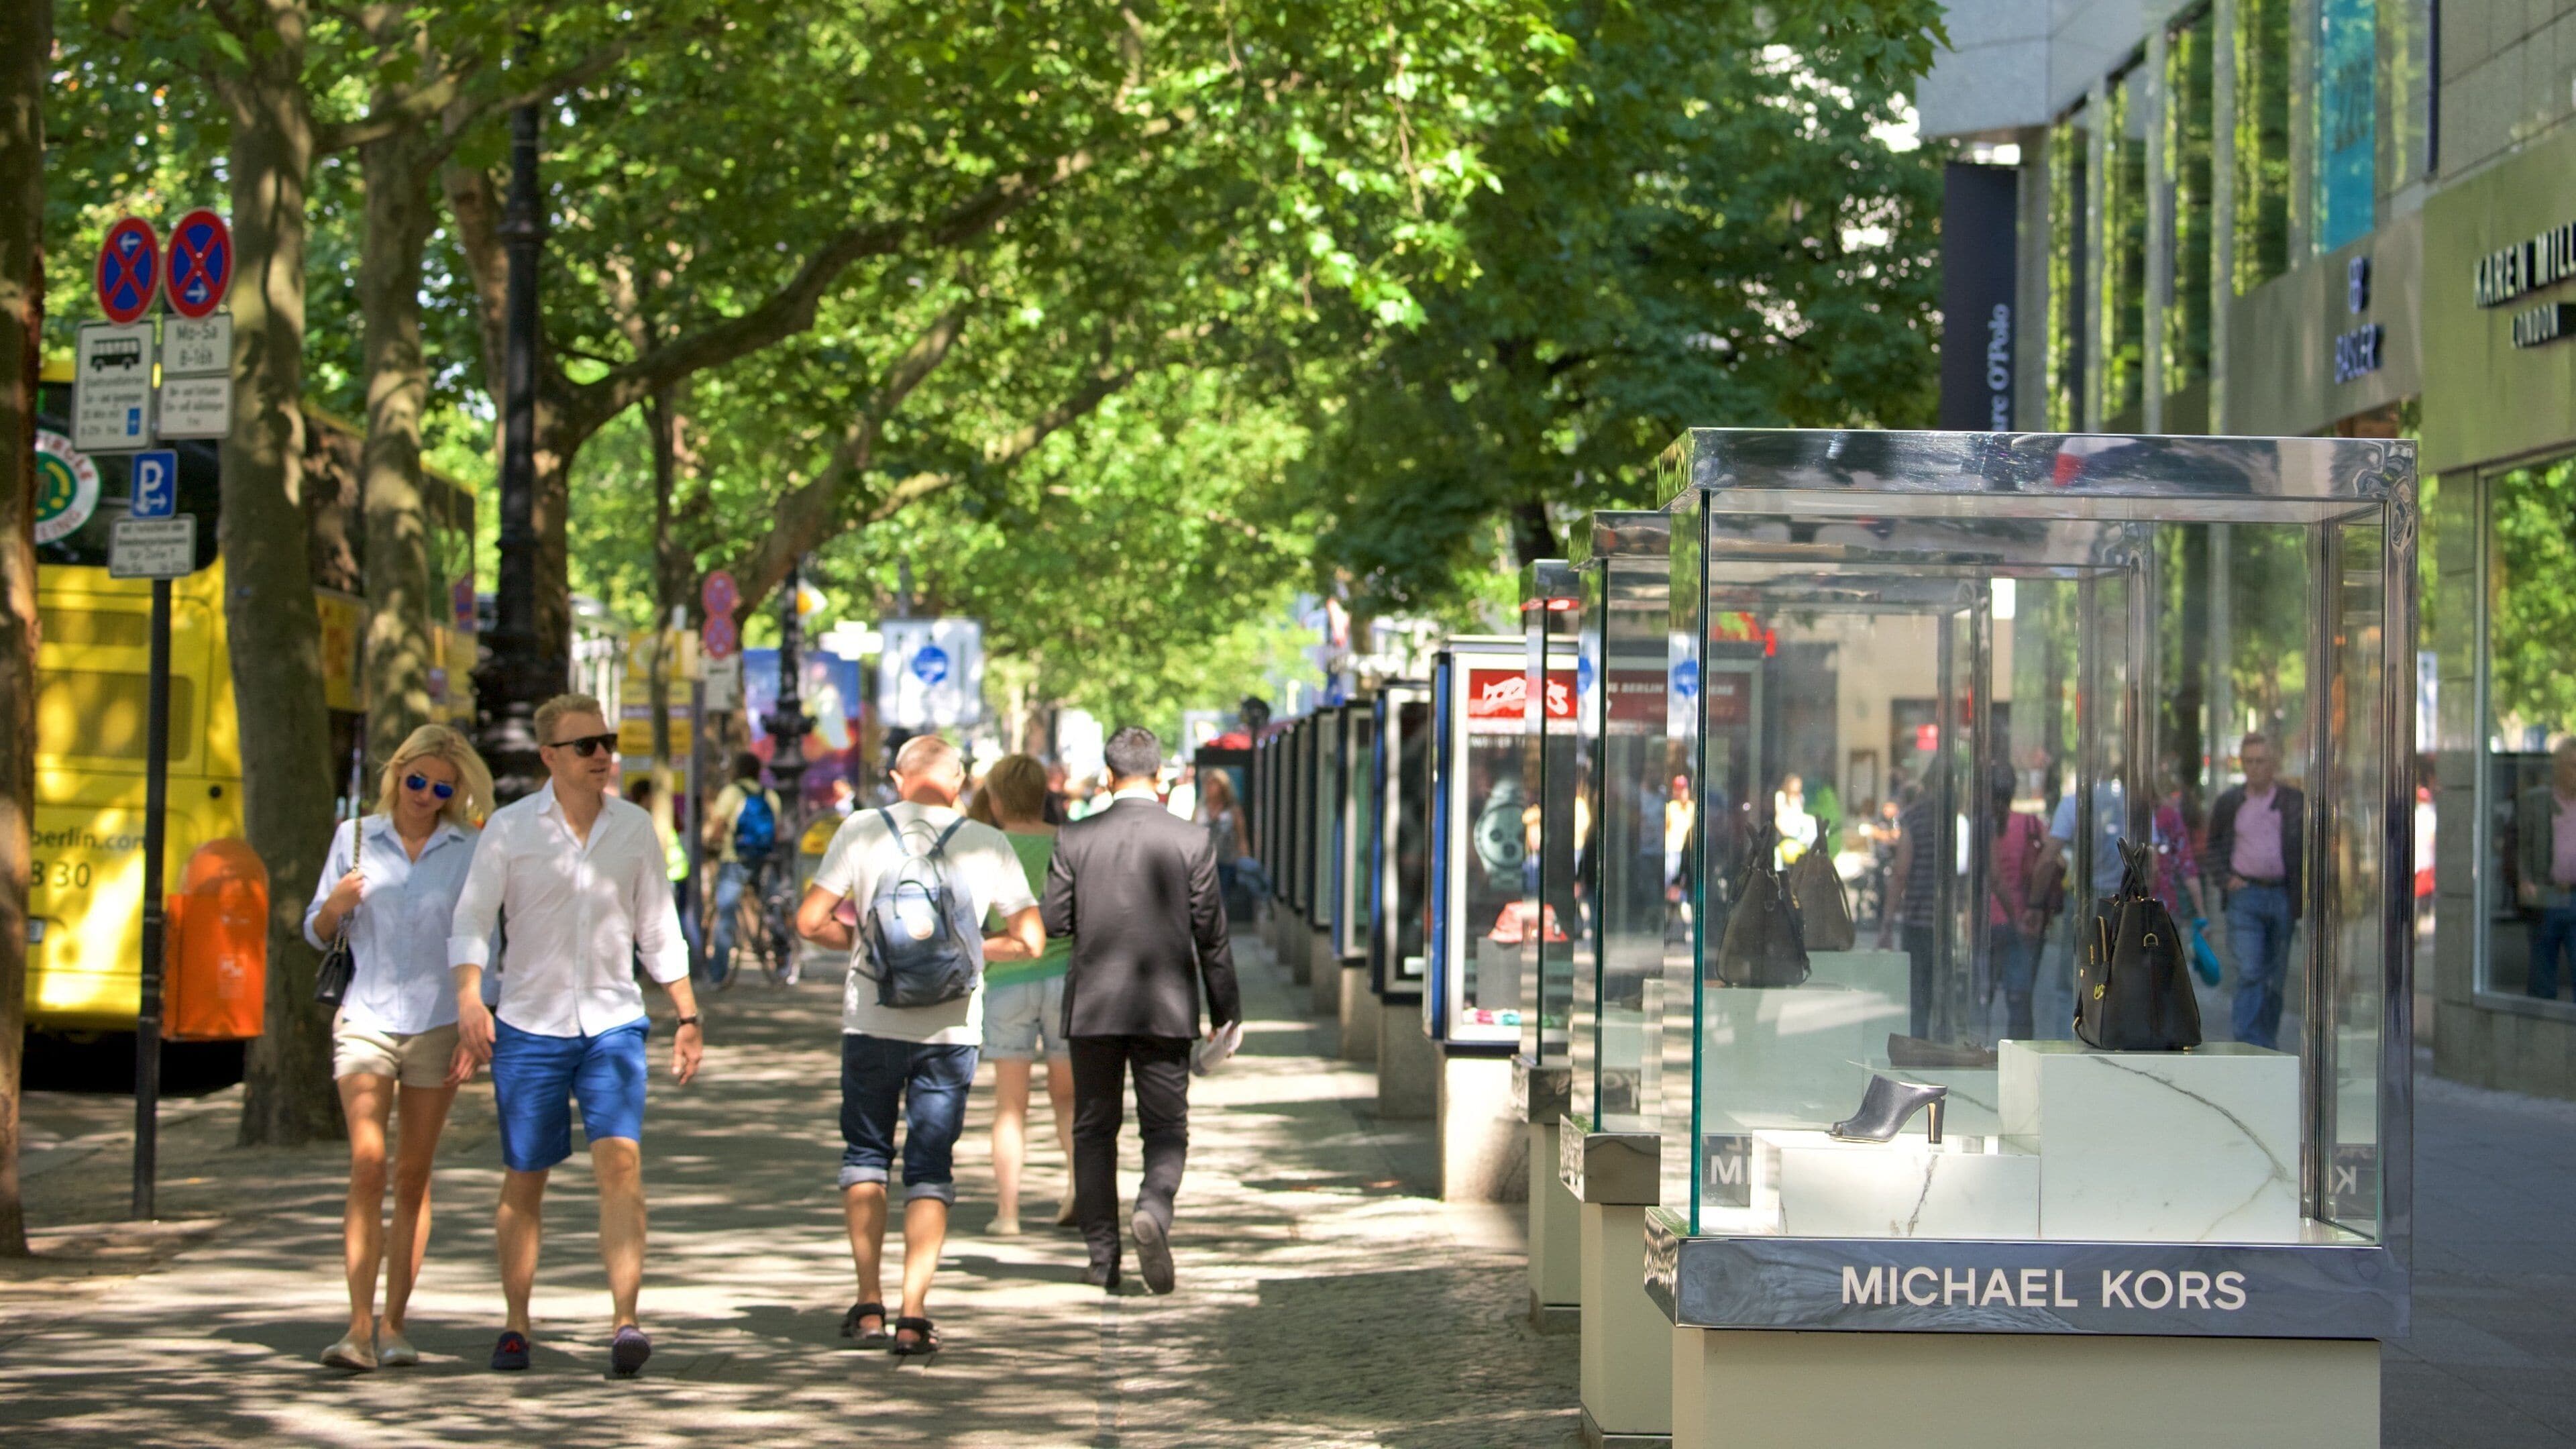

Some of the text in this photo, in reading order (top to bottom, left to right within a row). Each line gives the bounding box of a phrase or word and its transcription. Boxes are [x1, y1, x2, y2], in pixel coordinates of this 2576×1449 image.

[138, 460, 164, 504] P
[1841, 1266, 2247, 1311] MICHAEL KORS
